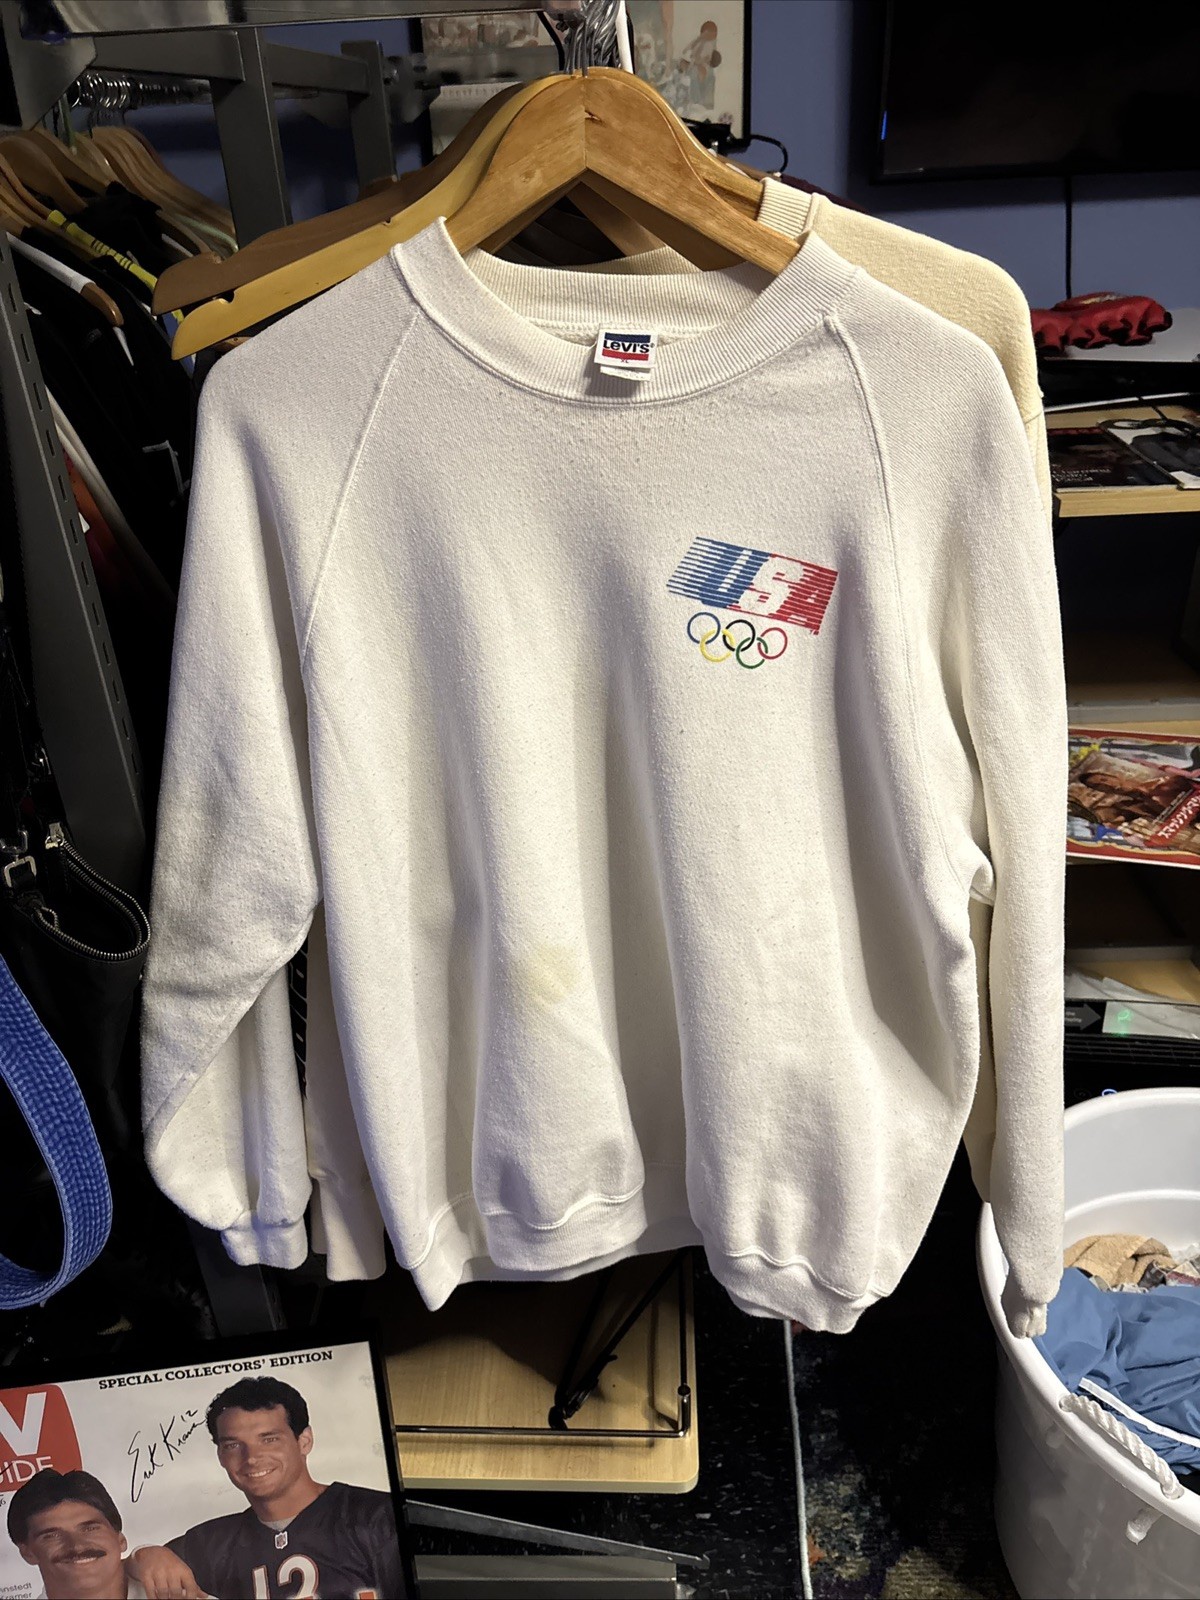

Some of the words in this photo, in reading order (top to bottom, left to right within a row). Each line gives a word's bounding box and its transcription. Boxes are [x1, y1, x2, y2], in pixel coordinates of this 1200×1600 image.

[668, 537, 838, 635] USA
[99, 1372, 162, 1389] SPECIAL
[165, 1359, 266, 1381] COLLECTORS'
[270, 1350, 333, 1368] EDITION
